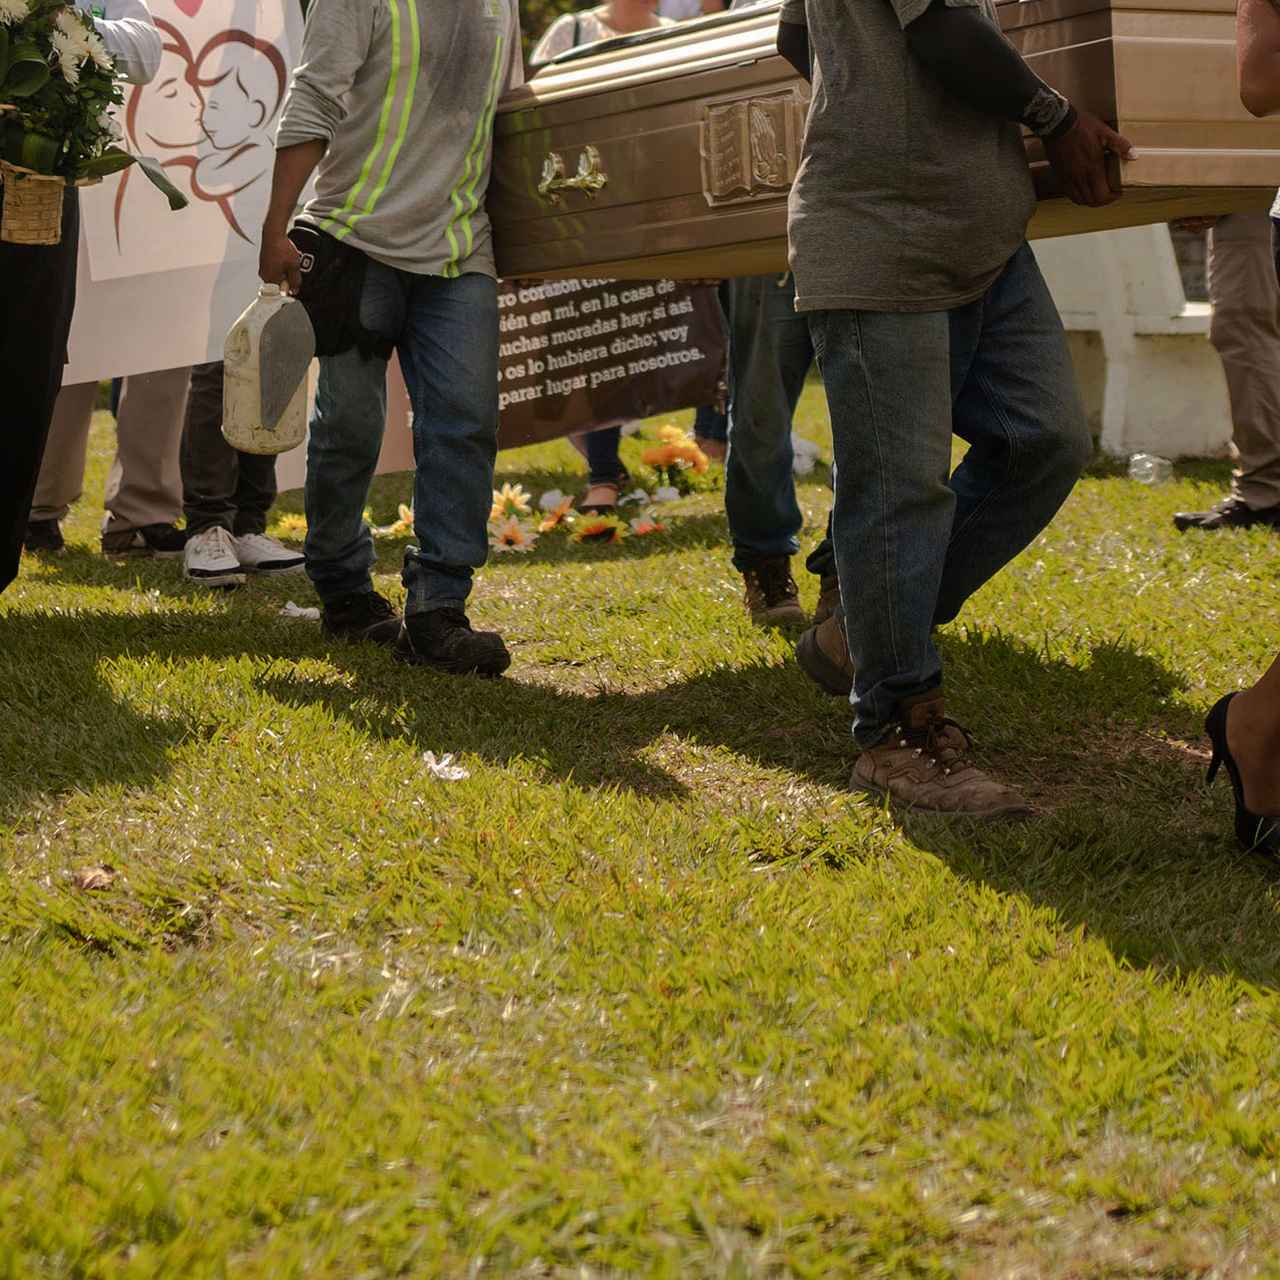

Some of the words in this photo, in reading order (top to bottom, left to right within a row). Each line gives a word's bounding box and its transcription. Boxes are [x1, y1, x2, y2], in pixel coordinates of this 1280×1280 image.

[530, 309, 553, 326] en
[581, 297, 603, 314] en
[603, 291, 619, 308] la
[620, 287, 655, 306] casa
[657, 278, 676, 295] de
[552, 317, 619, 346] moradas
[506, 363, 526, 381] os
[527, 358, 545, 376] lo
[547, 345, 608, 371] hubiera
[659, 324, 689, 344] voy
[546, 372, 589, 396] lugar
[590, 364, 626, 388] para
